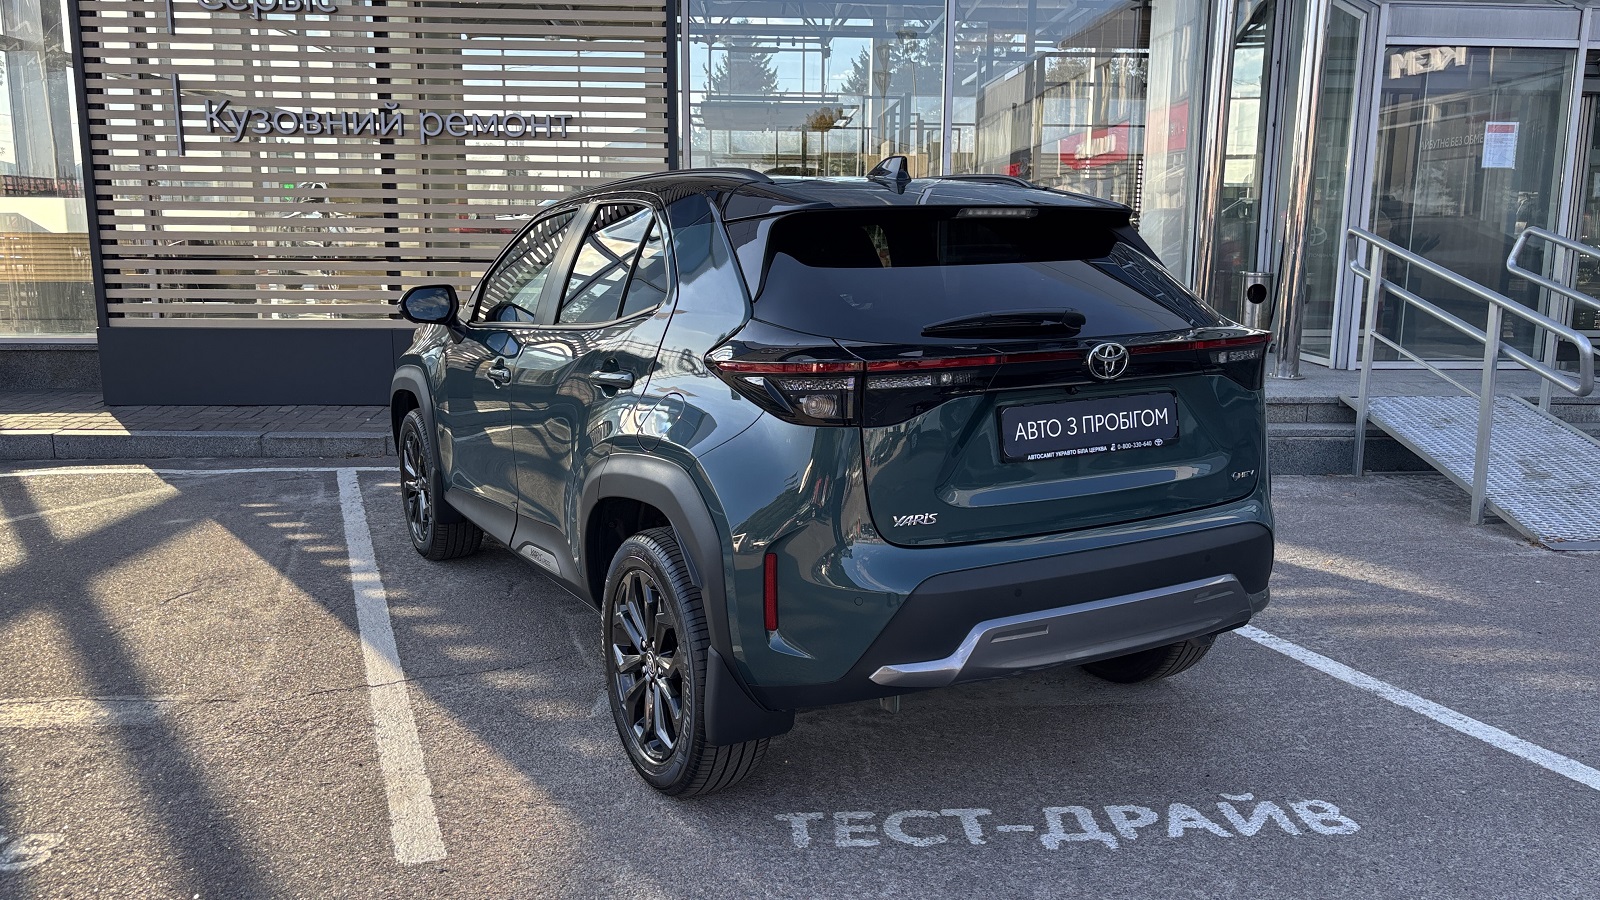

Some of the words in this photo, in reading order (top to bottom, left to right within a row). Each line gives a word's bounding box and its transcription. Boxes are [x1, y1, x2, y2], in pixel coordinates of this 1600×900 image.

[204, 99, 405, 143] Кузовний
[419, 110, 573, 145] ремонт
[1014, 418, 1062, 442] АВТО
[1082, 407, 1169, 434] ПРОБІГОМ
[774, 792, 1362, 850] ТЕСТ-ДРАЙВ
